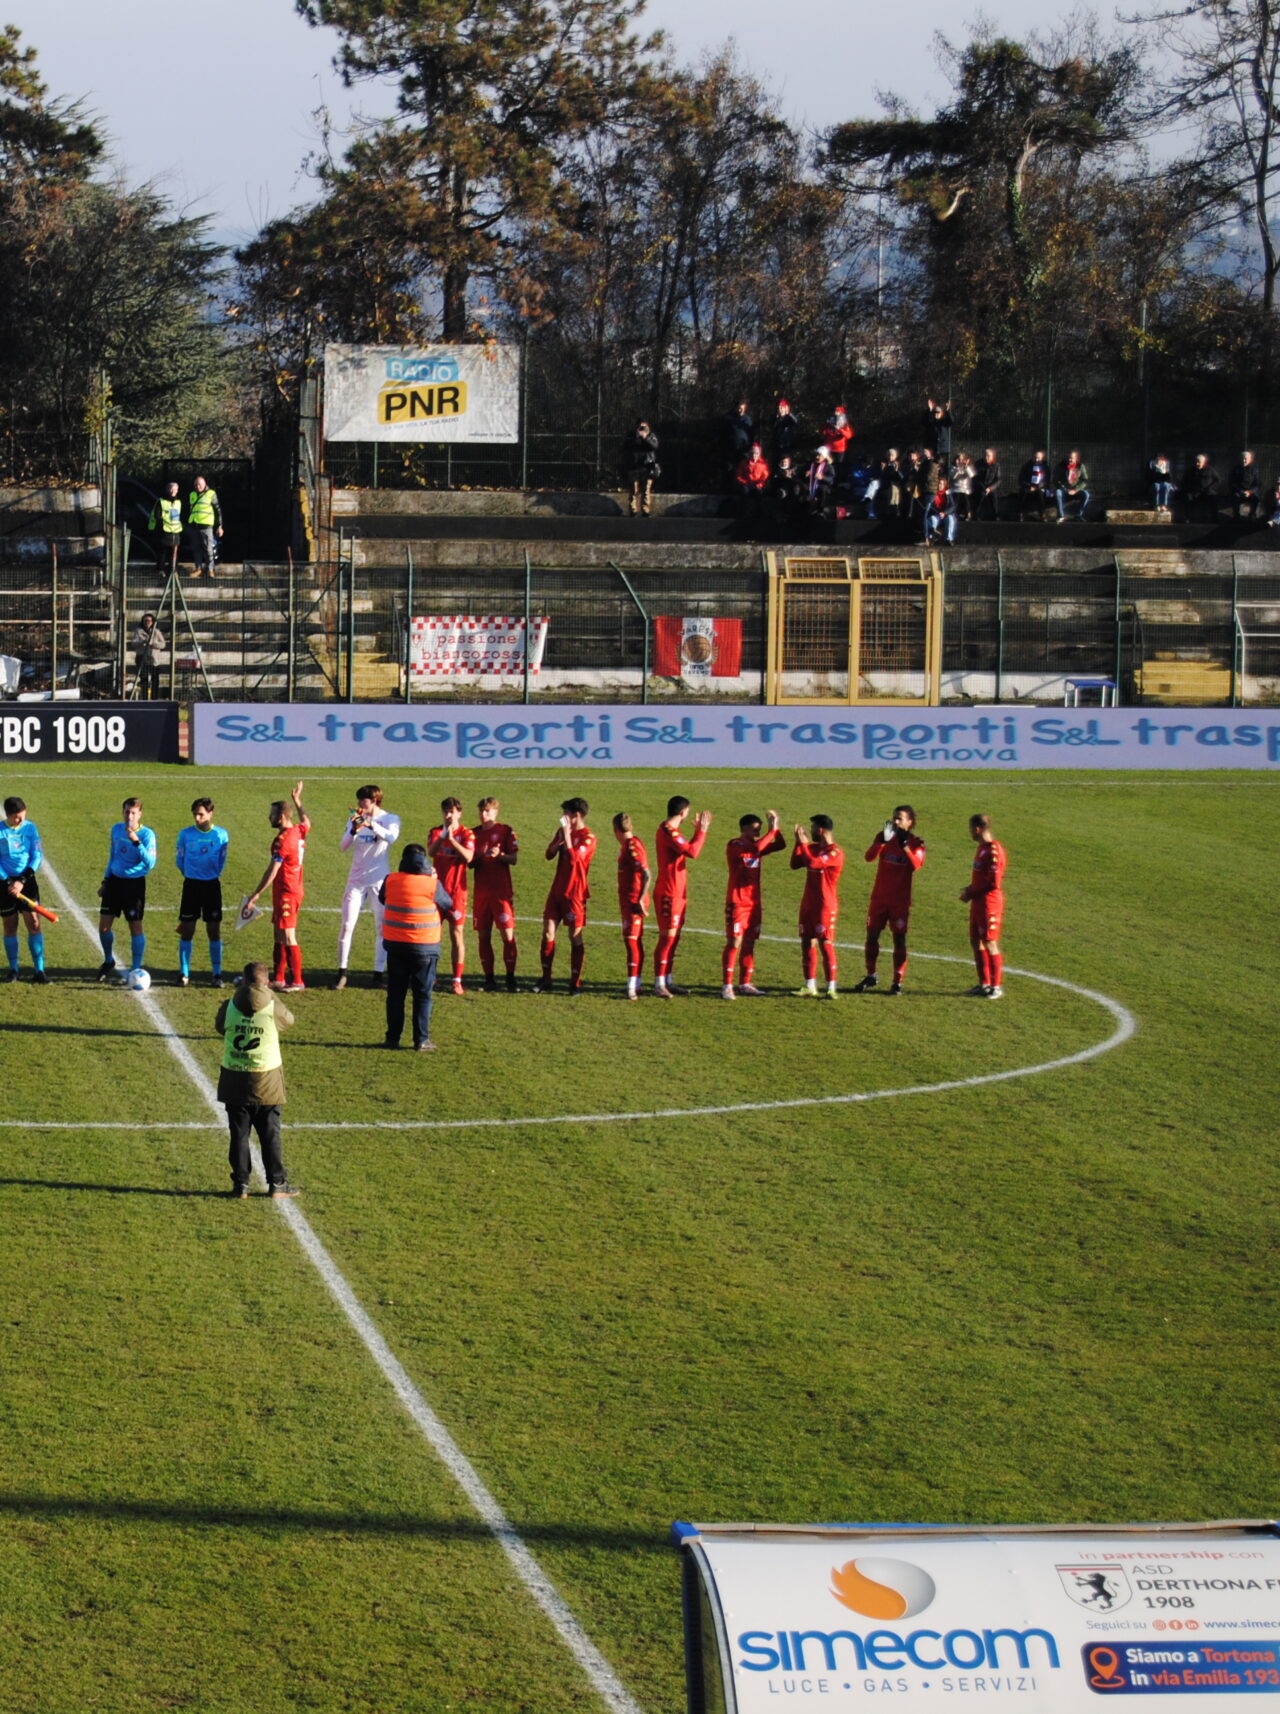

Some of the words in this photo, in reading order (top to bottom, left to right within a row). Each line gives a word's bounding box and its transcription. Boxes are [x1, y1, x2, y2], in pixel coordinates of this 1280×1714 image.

[390, 361, 453, 381] RADIO
[385, 386, 459, 421] PNR
[437, 634, 517, 648] passione
[53, 716, 126, 753] 1908
[216, 715, 307, 742] S&L
[319, 714, 610, 757] trasporti
[625, 717, 715, 743] S&L
[726, 715, 1016, 759] trasporti
[1031, 719, 1121, 745] S&L
[470, 742, 613, 759] Genova
[875, 743, 1017, 761] Genova
[1079, 1552, 1097, 1560] in
[1102, 1551, 1224, 1560] partnership
[1228, 1551, 1264, 1559] con
[1131, 1565, 1174, 1575] ASD
[1136, 1579, 1262, 1591] DERTHONA
[1266, 1579, 1280, 1590] F
[1144, 1597, 1195, 1609] 1908
[1086, 1620, 1131, 1631] Seguici
[1133, 1622, 1147, 1630] su
[1203, 1619, 1280, 1629] www.simec
[738, 1627, 1061, 1672] simecom
[1126, 1648, 1185, 1664] Siamo
[1187, 1651, 1199, 1664] a
[1200, 1648, 1275, 1664] Tortona
[768, 1678, 830, 1694] LUCE
[863, 1678, 909, 1693] GAS
[942, 1676, 1037, 1693] SERVIZI
[1131, 1670, 1149, 1686] in
[1152, 1670, 1180, 1685] via
[1182, 1669, 1241, 1685] Emilia
